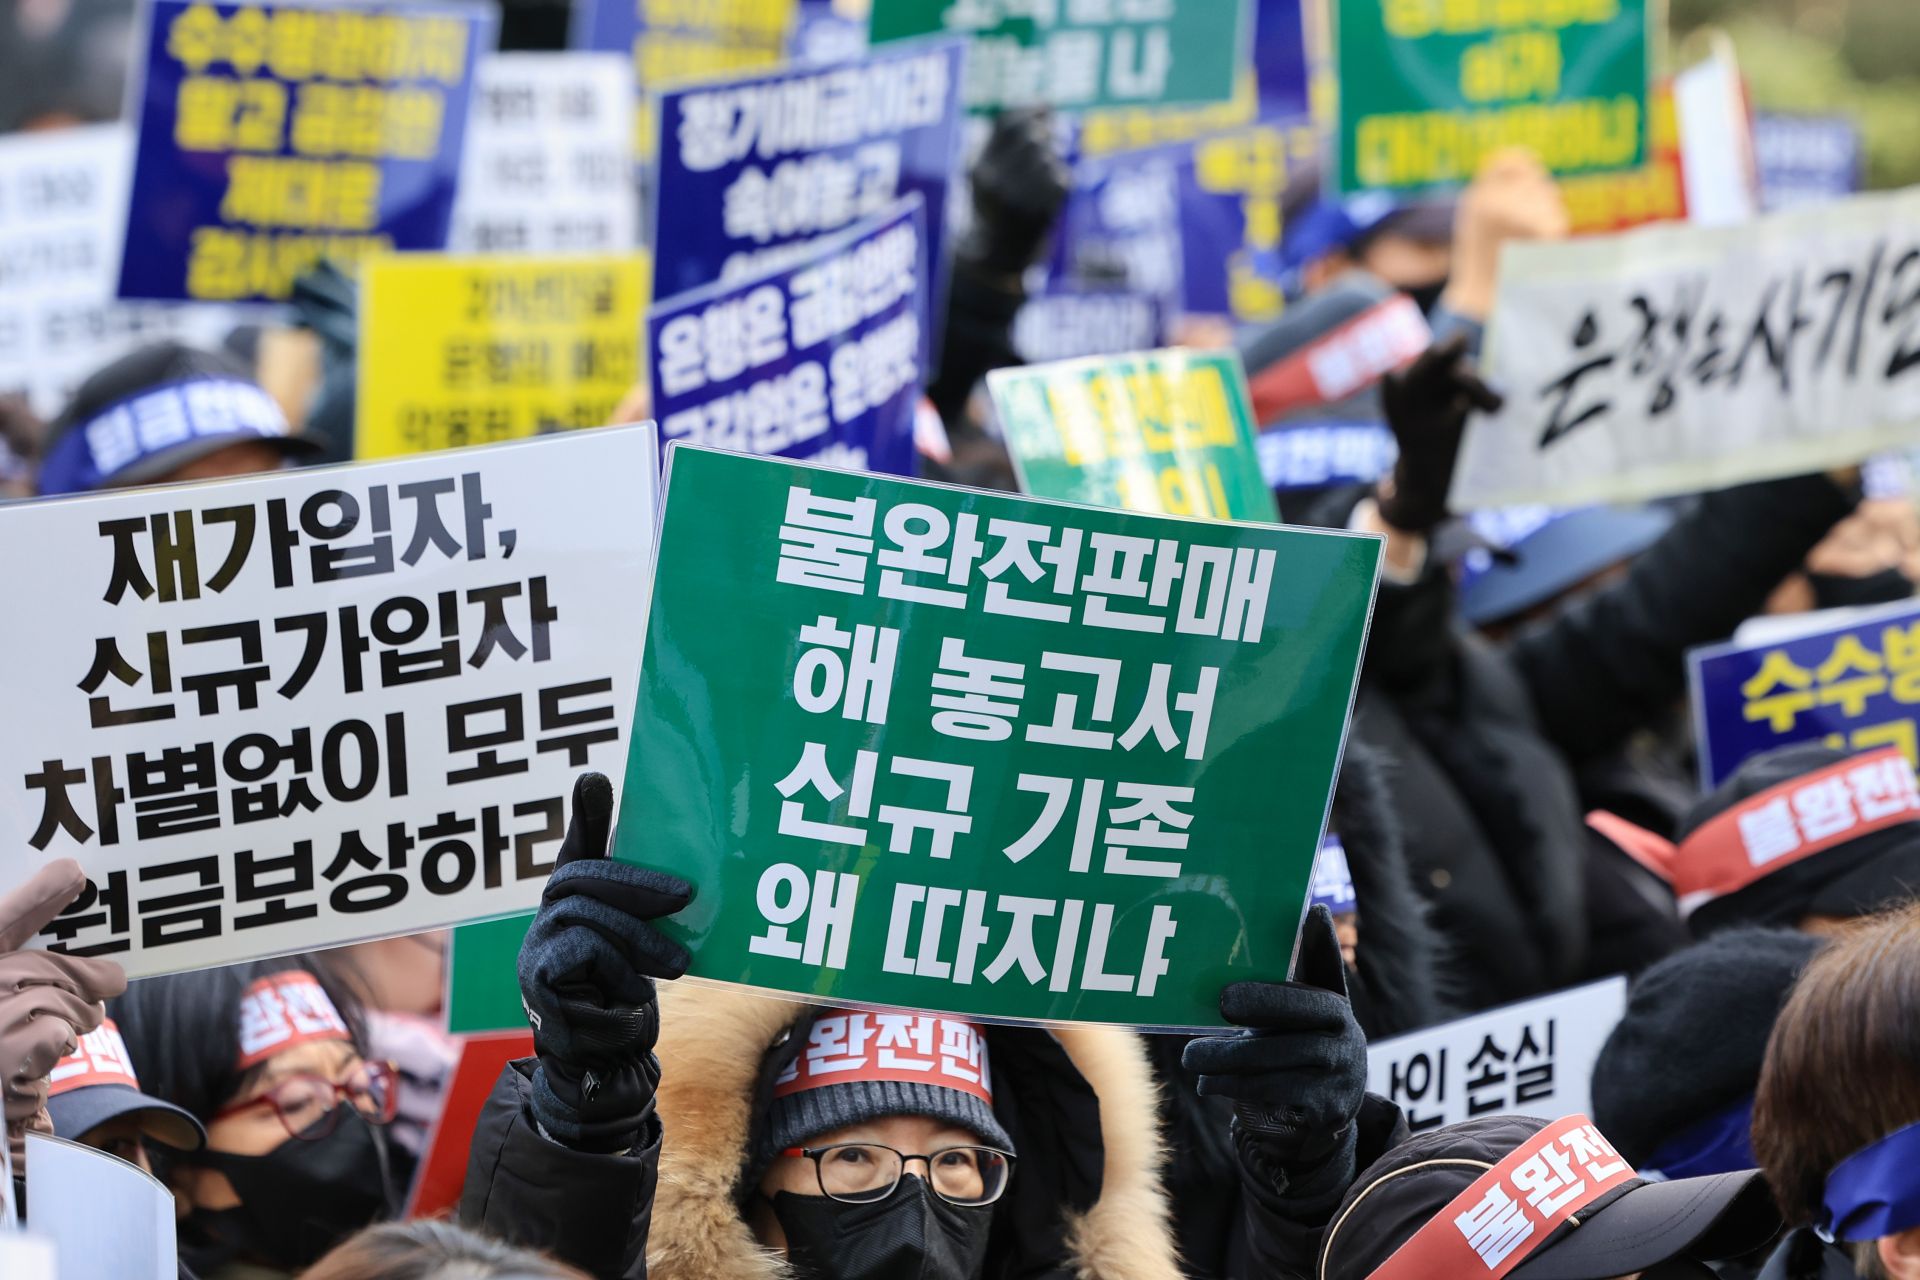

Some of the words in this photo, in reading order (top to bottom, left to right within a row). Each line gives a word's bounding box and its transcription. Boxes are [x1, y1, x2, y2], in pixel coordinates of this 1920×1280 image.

[659, 284, 788, 397] 은행은
[98, 471, 517, 606] 재가입자,
[775, 486, 1277, 643] 불완전판매
[77, 575, 558, 729] 신규가입자
[792, 615, 900, 725] 해
[930, 636, 1220, 760] 놓고서
[24, 711, 409, 852] 차별없이
[444, 677, 619, 786] 모두
[773, 742, 974, 860] 신규
[1002, 773, 1195, 878] 기존
[1737, 756, 1920, 869] 불완전
[748, 862, 860, 970] 왜
[881, 881, 1178, 997] 따지냐
[240, 984, 350, 1056] 완전
[775, 1013, 992, 1094] 완전판
[1465, 1018, 1556, 1117] 손실
[1454, 1125, 1626, 1270] 불완전
